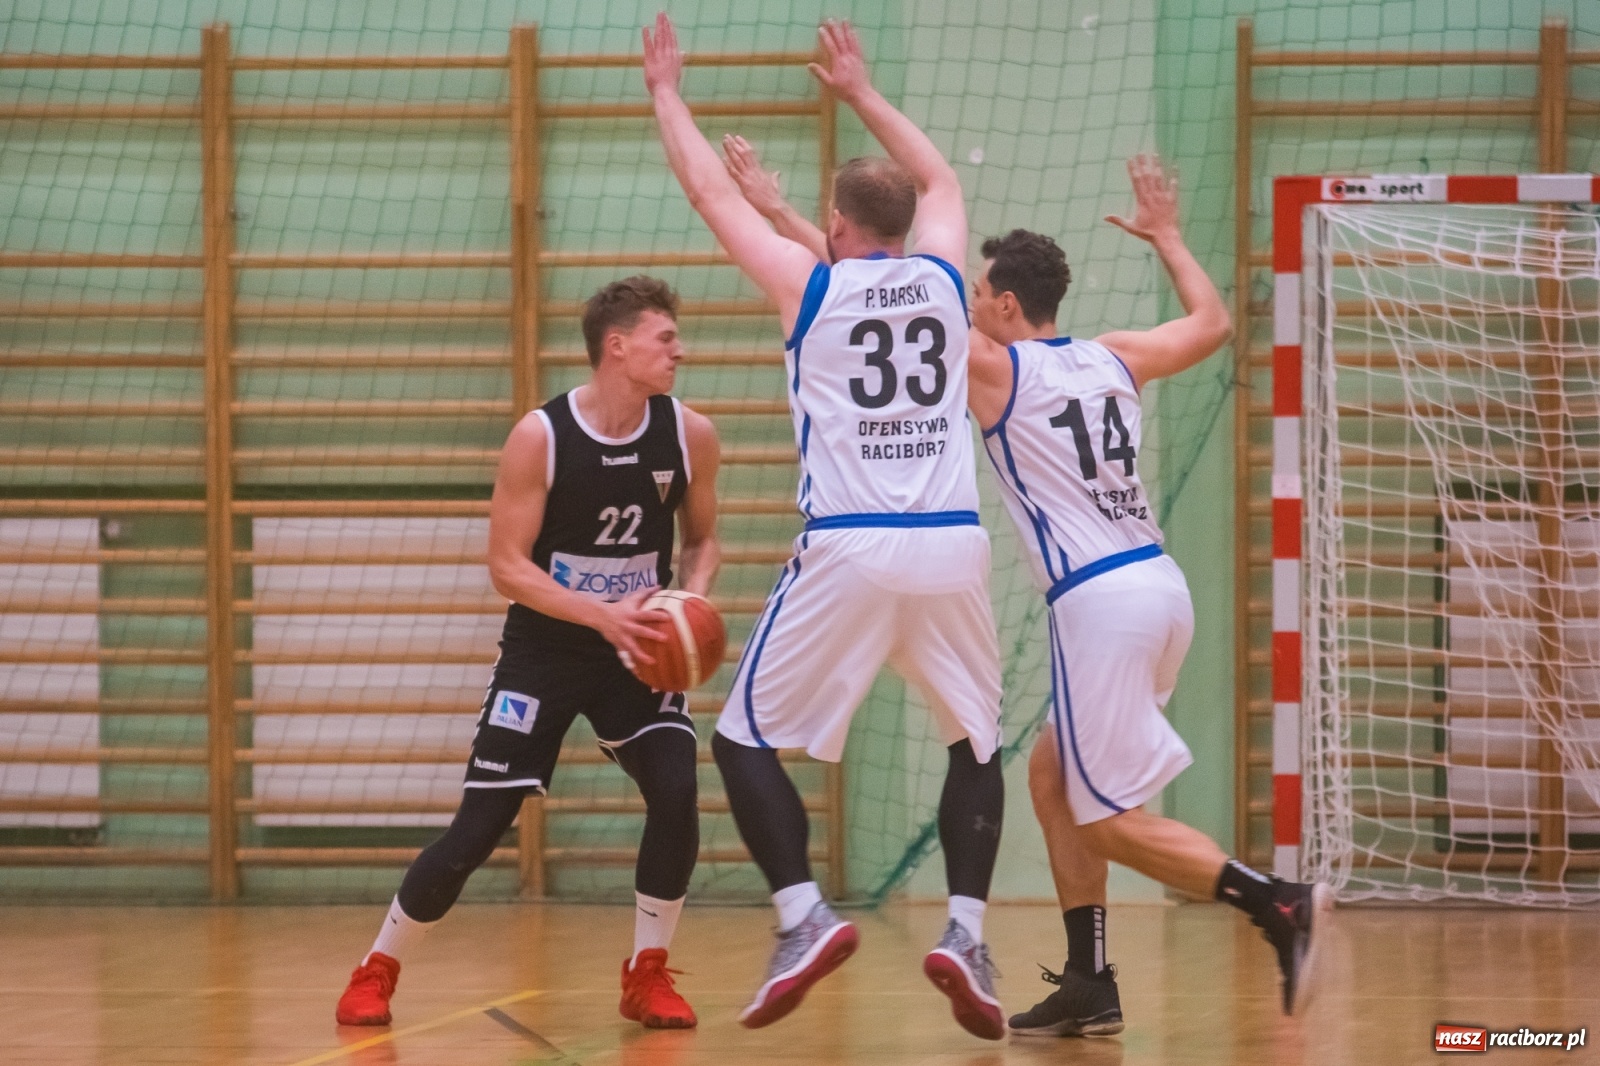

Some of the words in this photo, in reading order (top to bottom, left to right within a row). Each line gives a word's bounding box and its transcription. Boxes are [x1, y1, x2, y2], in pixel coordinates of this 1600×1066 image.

[1380, 182, 1424, 198] sport
[865, 288, 876, 308] P.
[879, 283, 930, 308] BARSKI
[849, 316, 947, 409] 33
[858, 417, 949, 437] OFENSYWA
[1048, 396, 1137, 481] 14
[593, 504, 643, 546] 22
[575, 567, 656, 594] ZOFSTAL
[473, 757, 509, 773] hummel
